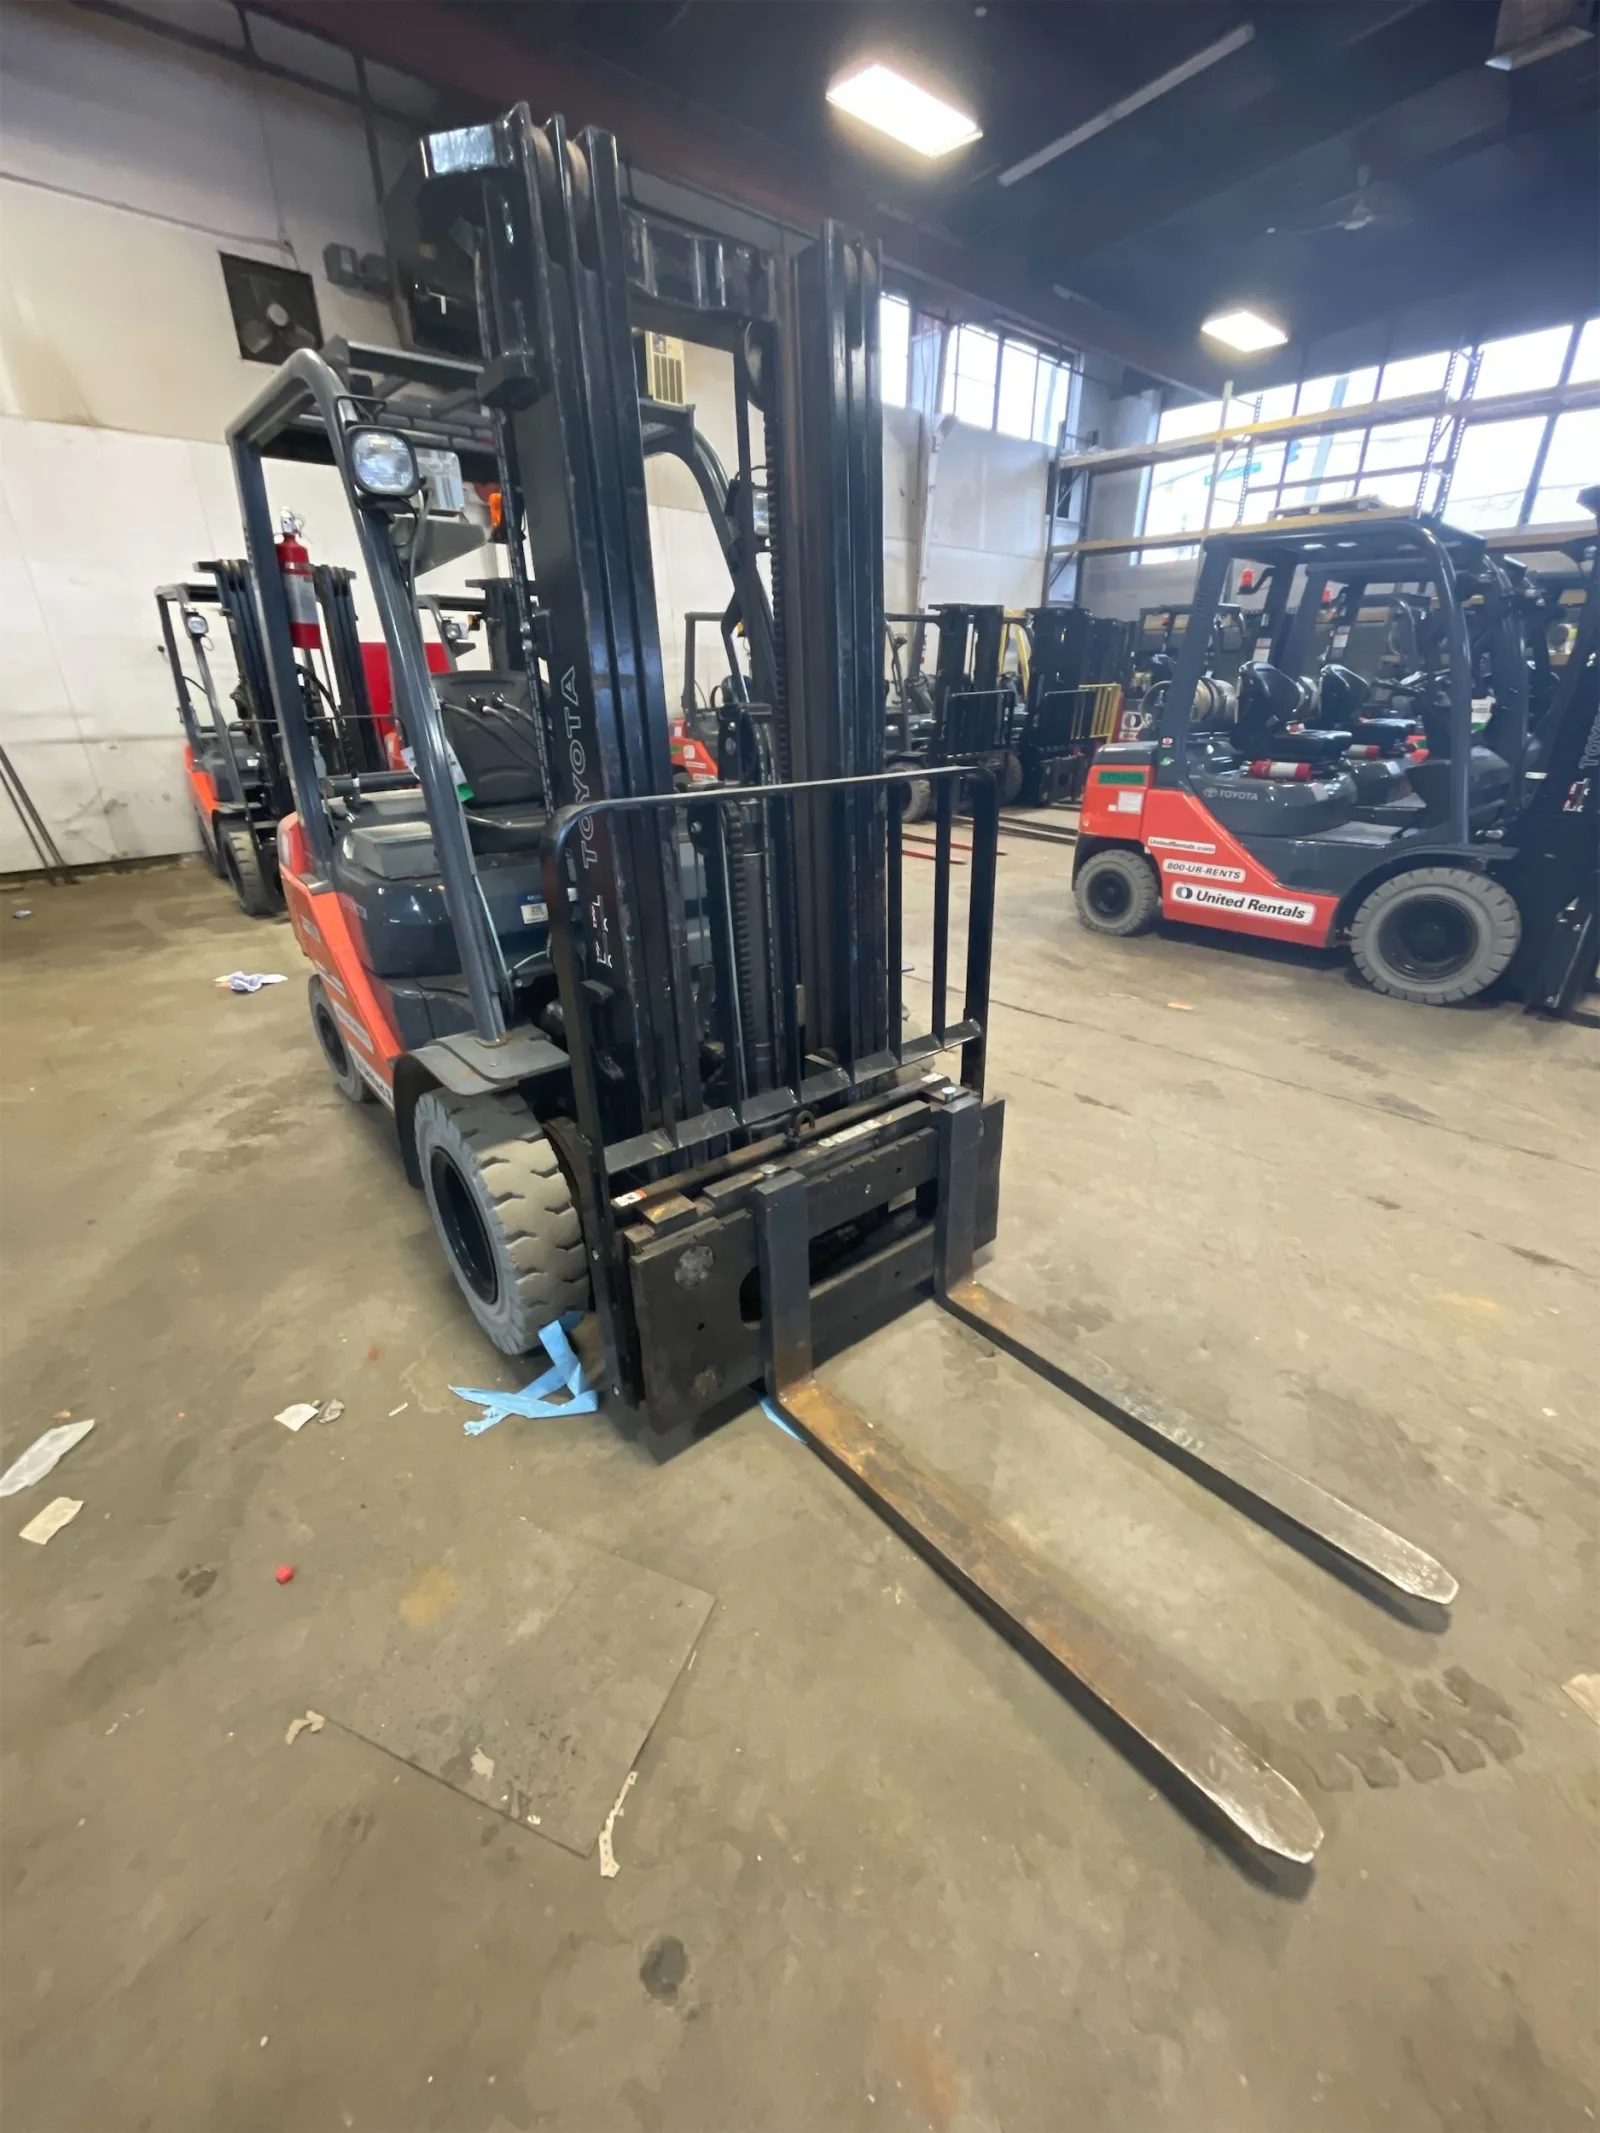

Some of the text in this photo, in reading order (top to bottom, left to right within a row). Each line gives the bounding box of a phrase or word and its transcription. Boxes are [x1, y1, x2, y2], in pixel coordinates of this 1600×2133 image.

[561, 666, 598, 869] TOYOTA
[1219, 790, 1258, 801] TOYOTA
[1167, 862, 1241, 879] 800-UR-RENTS
[1196, 890, 1305, 919] United Rentals
